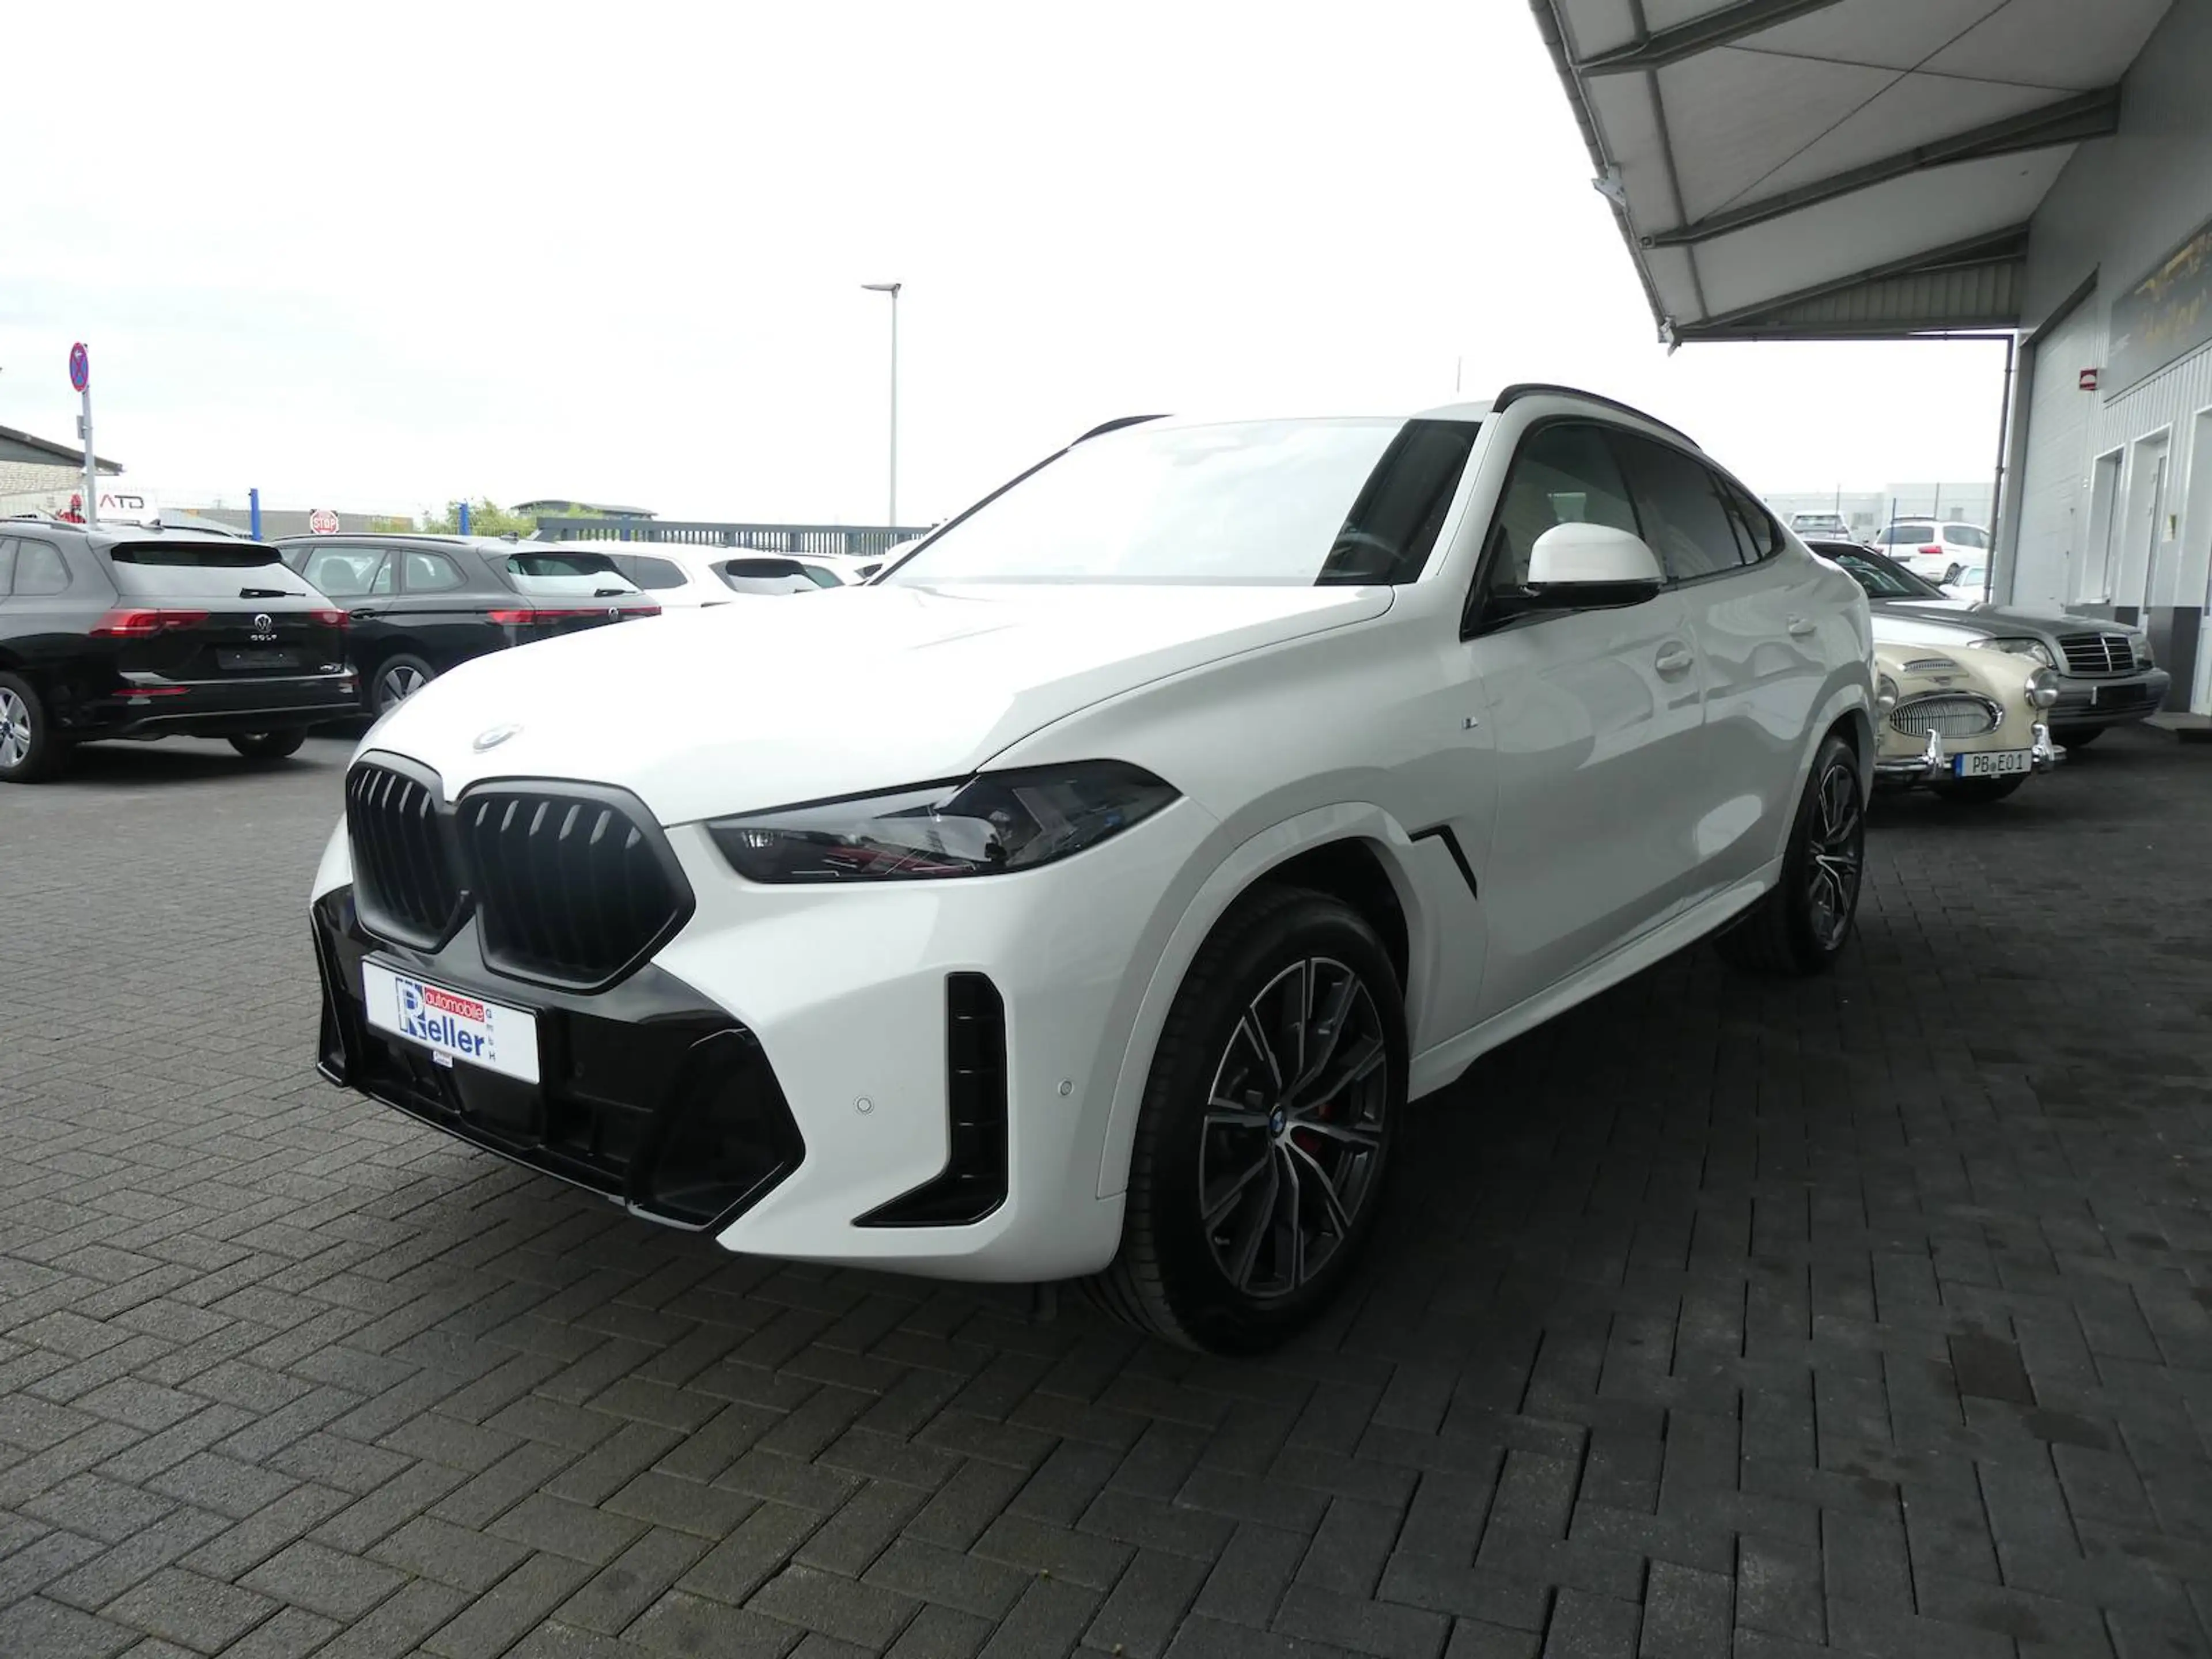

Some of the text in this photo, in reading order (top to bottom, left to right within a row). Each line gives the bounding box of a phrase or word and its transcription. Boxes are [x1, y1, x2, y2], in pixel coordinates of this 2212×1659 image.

[313, 518, 336, 529] STOP
[1972, 756, 1989, 774] PB
[395, 976, 484, 1056] Keller
[425, 991, 484, 1021] automobile
